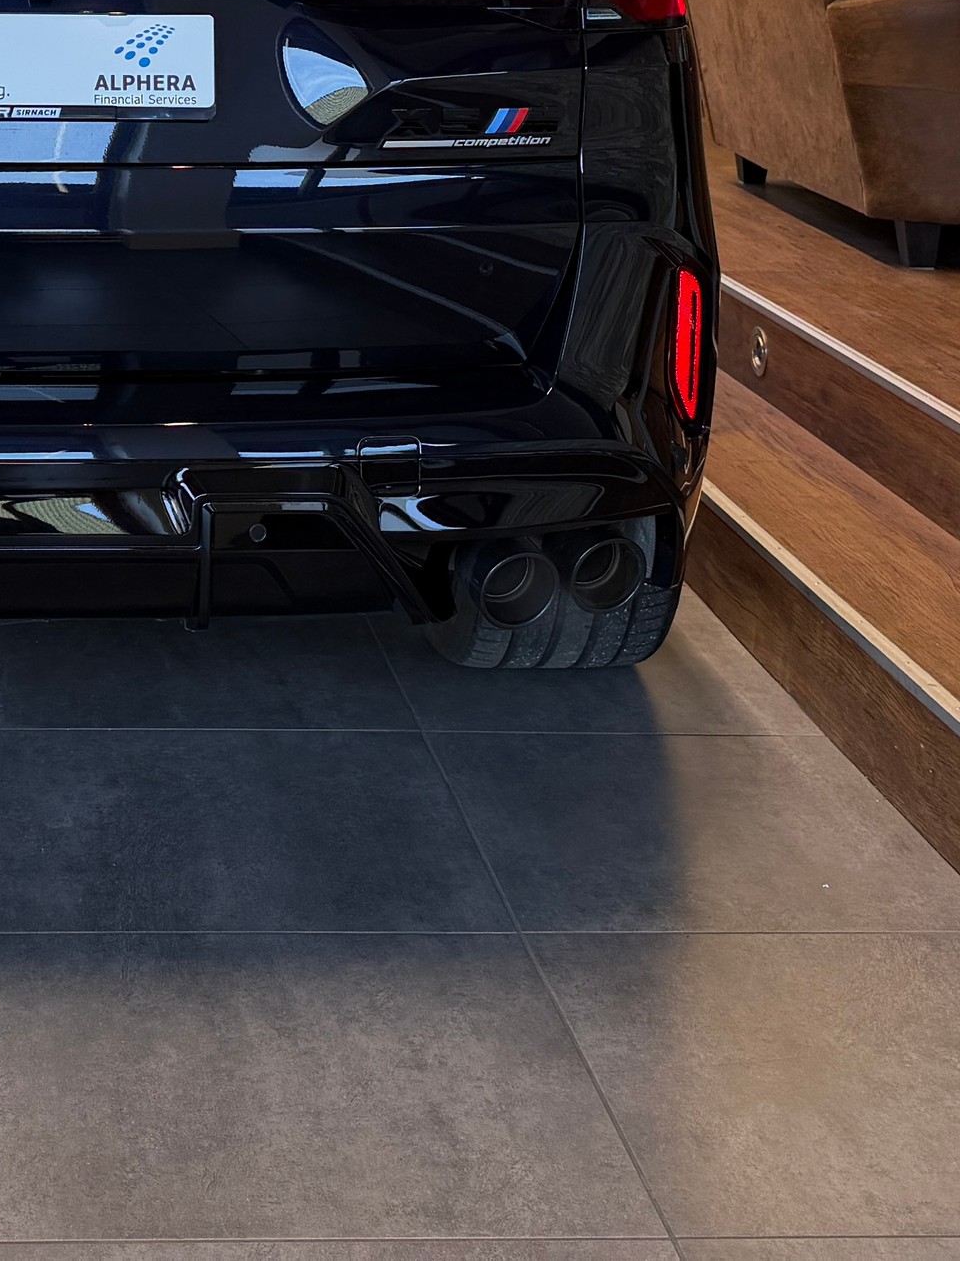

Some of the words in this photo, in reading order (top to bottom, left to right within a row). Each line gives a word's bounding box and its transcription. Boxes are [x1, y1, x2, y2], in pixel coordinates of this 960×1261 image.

[94, 74, 196, 91] ALPHERA
[94, 94, 144, 105] Financial
[148, 94, 197, 105] Services
[16, 108, 57, 116] SIRNACH
[454, 136, 551, 148] competition
